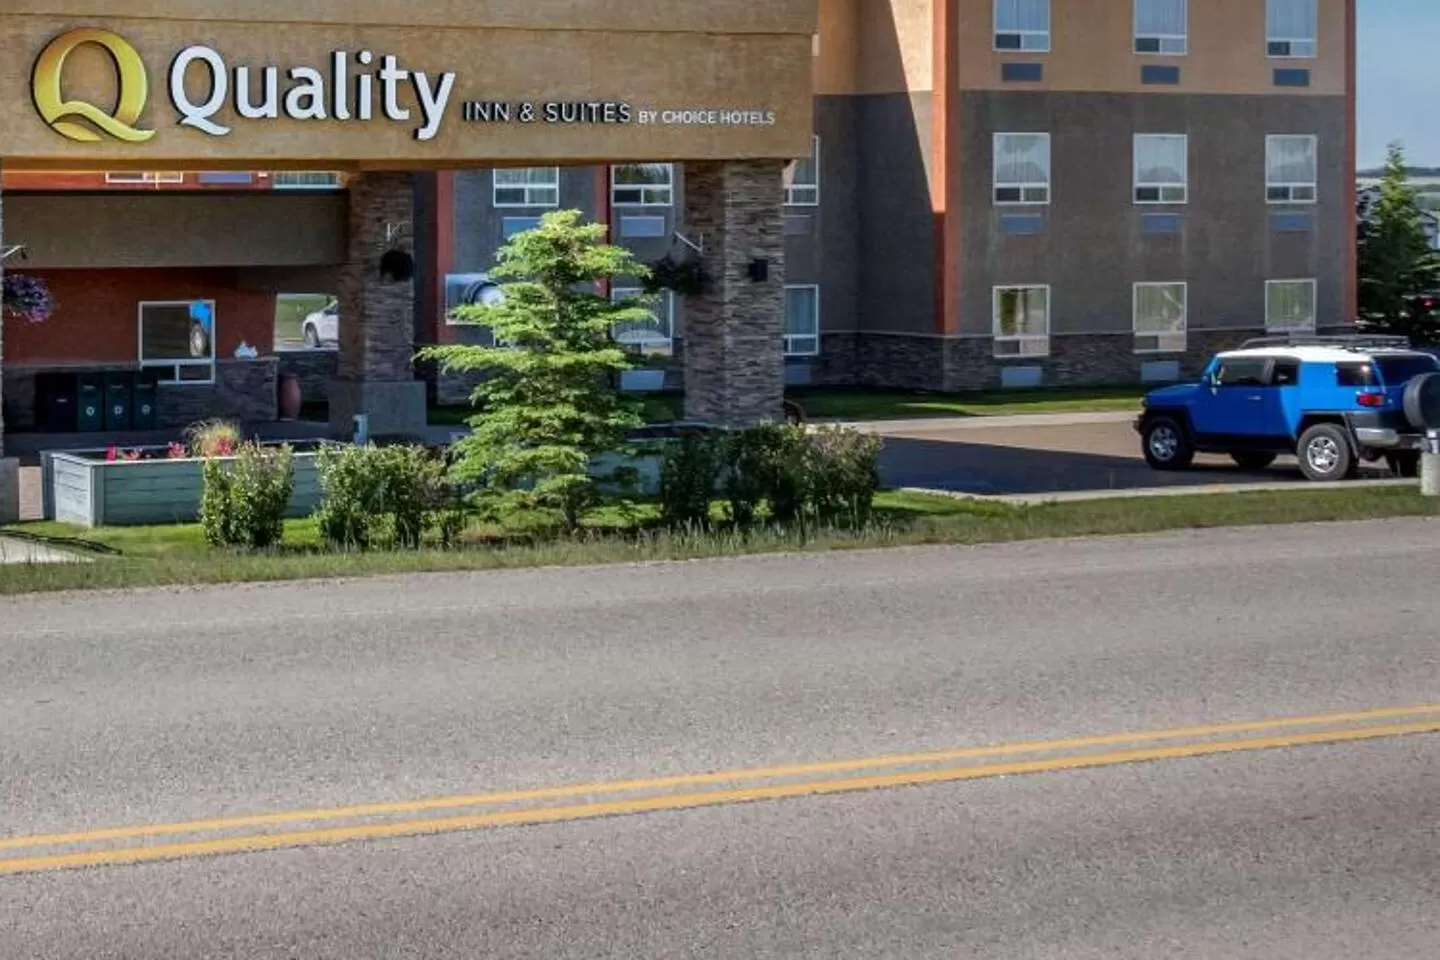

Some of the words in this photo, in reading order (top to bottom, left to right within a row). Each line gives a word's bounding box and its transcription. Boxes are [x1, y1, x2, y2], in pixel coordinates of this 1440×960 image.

[31, 27, 155, 142] Q
[169, 44, 456, 140] Quality
[464, 102, 510, 122] INN
[519, 102, 535, 123] &
[544, 102, 631, 123] SUITES
[638, 110, 657, 124] BY
[662, 110, 717, 124] CHOICE
[719, 110, 776, 125] HOTELS
